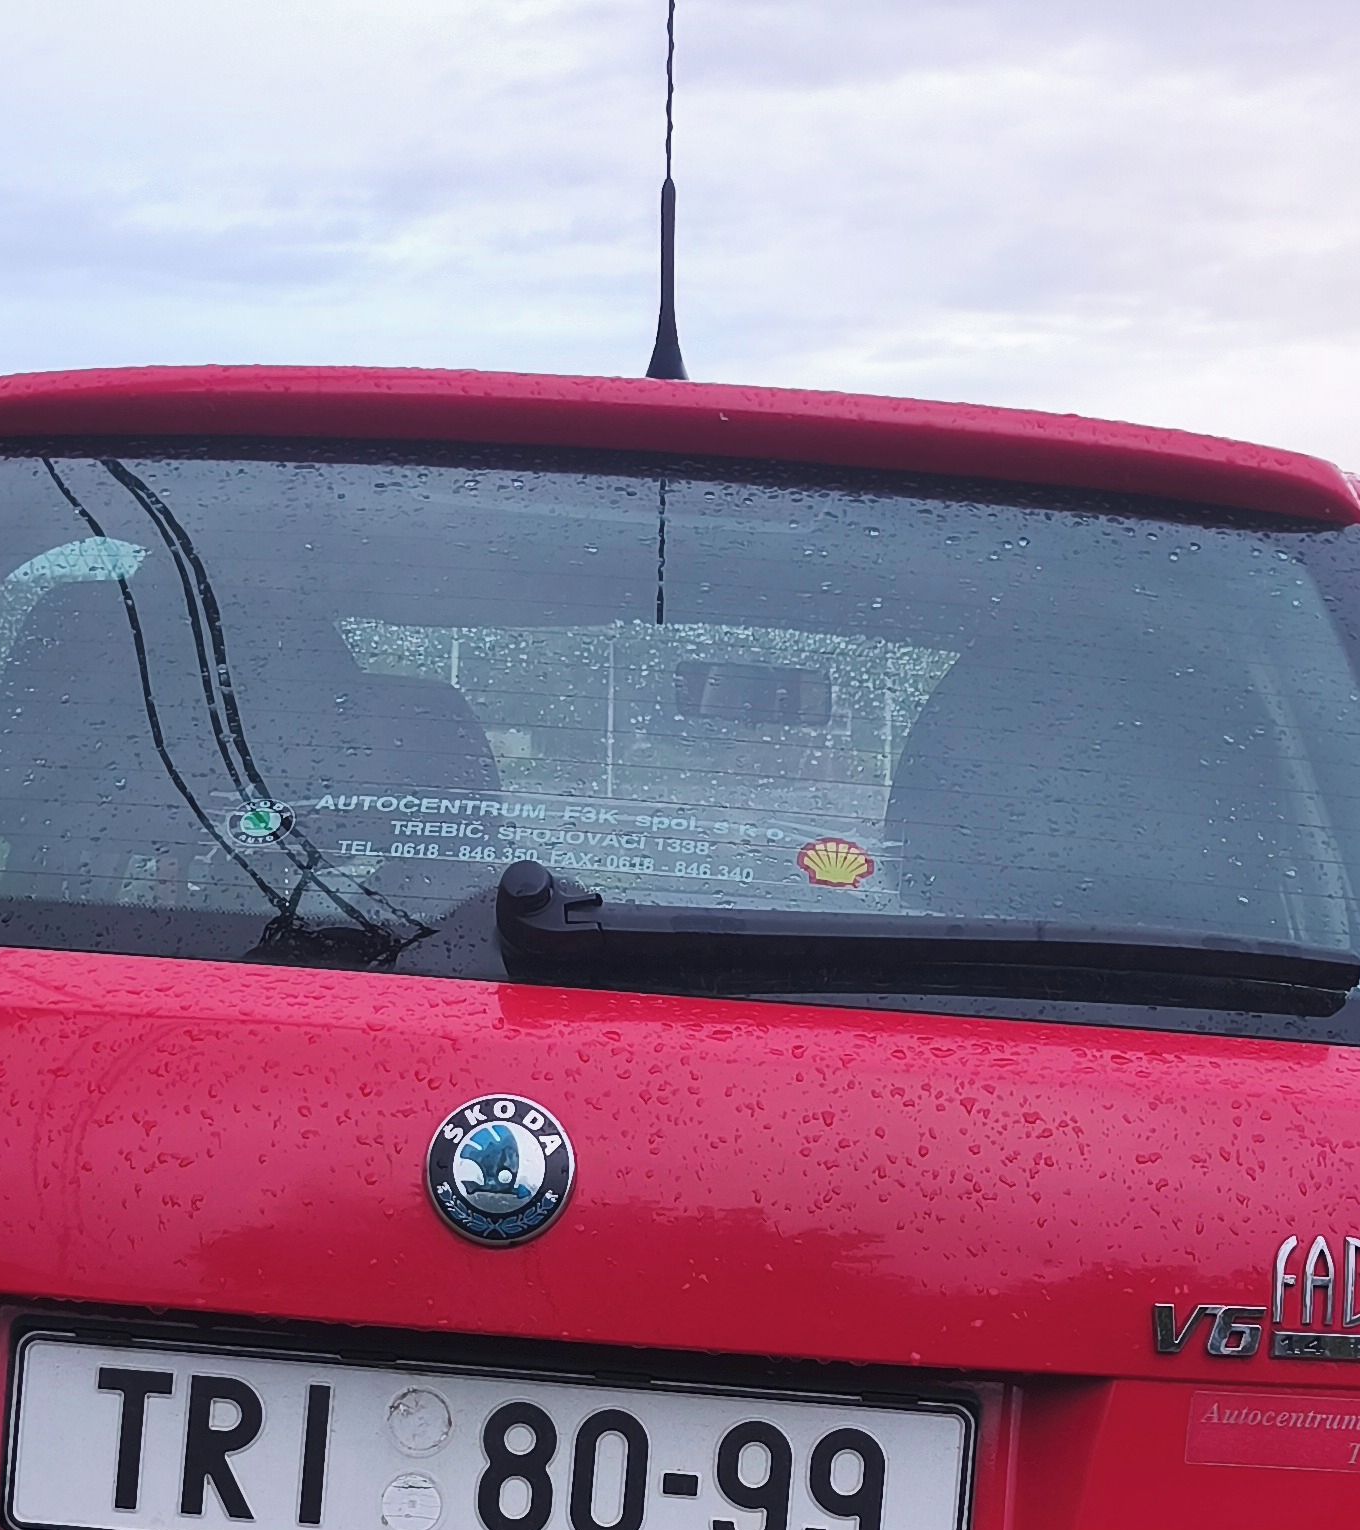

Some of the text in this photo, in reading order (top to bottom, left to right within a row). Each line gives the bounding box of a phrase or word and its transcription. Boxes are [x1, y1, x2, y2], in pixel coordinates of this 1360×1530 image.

[315, 794, 546, 819] AUTOCENTRUM
[563, 806, 619, 825] F3K
[339, 840, 383, 856] TEL.
[391, 843, 439, 858] 0618
[459, 845, 496, 861] 846
[674, 861, 711, 877] 846
[718, 865, 754, 882] 340
[655, 838, 709, 855] 1338
[1153, 1303, 1267, 1356] V6
[97, 1366, 332, 1525] TRI
